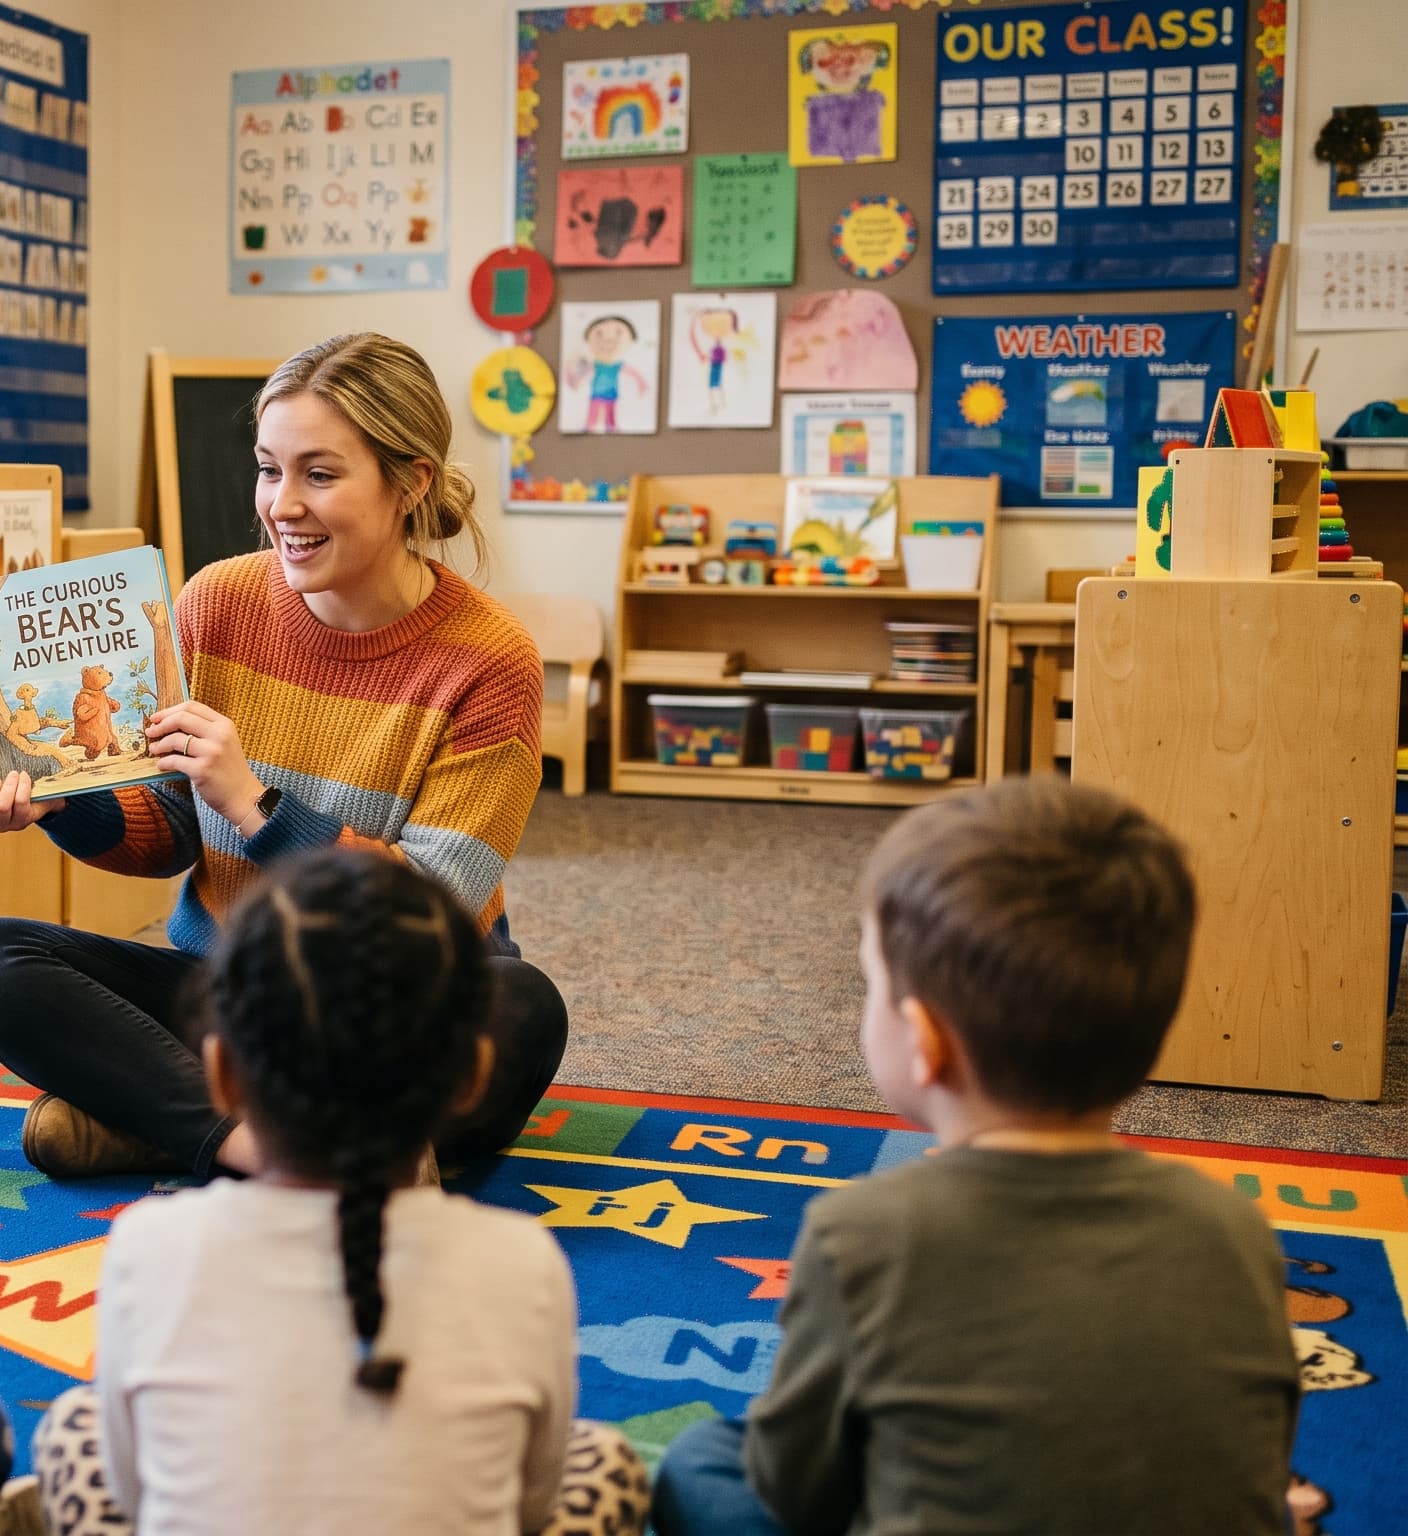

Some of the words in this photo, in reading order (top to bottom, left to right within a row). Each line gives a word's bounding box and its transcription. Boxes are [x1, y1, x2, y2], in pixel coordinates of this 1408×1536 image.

[944, 20, 1046, 63] OUR
[1064, 6, 1234, 55] CLASS!
[1077, 109, 1090, 129] 3
[1121, 106, 1135, 125] 4
[1165, 104, 1178, 123] 5
[1208, 102, 1221, 121] 6
[1073, 145, 1095, 165] 10
[1117, 143, 1134, 162] 11
[1159, 141, 1181, 160] 12
[1203, 139, 1226, 158] 13
[984, 185, 1009, 203] 23
[1026, 183, 1051, 202] 24
[1068, 181, 1093, 200] 25
[1110, 180, 1137, 198] 26
[1156, 178, 1182, 197] 27
[1198, 177, 1226, 196] 27
[943, 222, 967, 241] 28
[984, 220, 1009, 239] 29
[1026, 218, 1053, 238] 30
[994, 323, 1166, 359] WEATHER
[4, 590, 36, 612] THE
[41, 572, 128, 605] CURIOUS
[16, 597, 126, 645] BEAR'S
[12, 628, 140, 671] ADVENTURE
